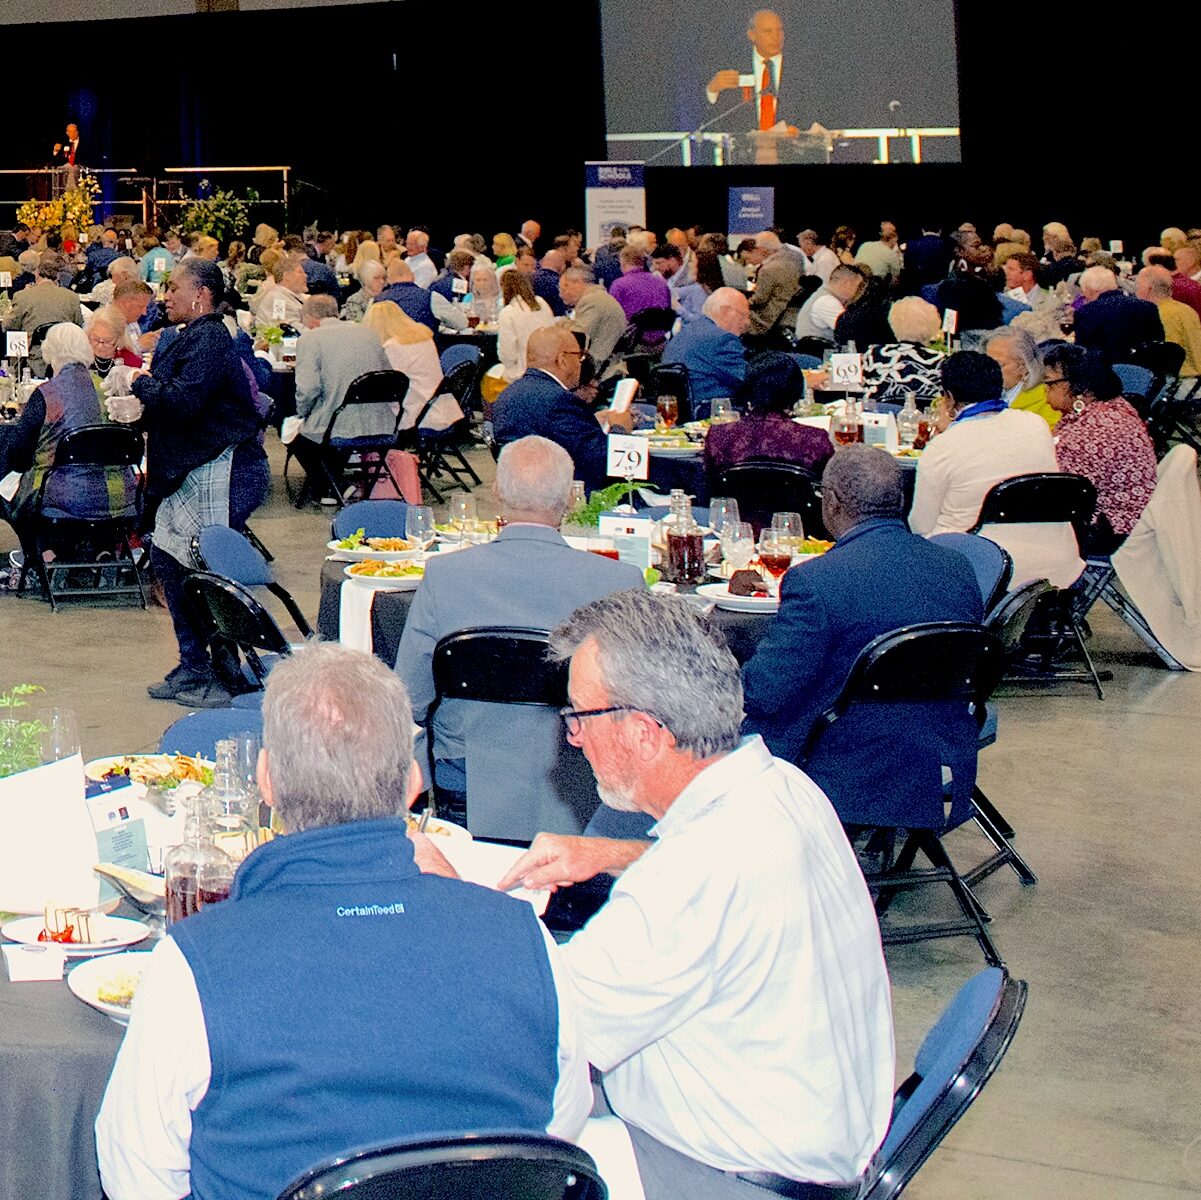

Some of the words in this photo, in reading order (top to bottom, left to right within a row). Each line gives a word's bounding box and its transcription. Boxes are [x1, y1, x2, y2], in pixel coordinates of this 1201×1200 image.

[9, 340, 27, 352] 68
[836, 362, 858, 378] 69
[614, 449, 642, 468] 79
[337, 904, 395, 917] CertainTeed
